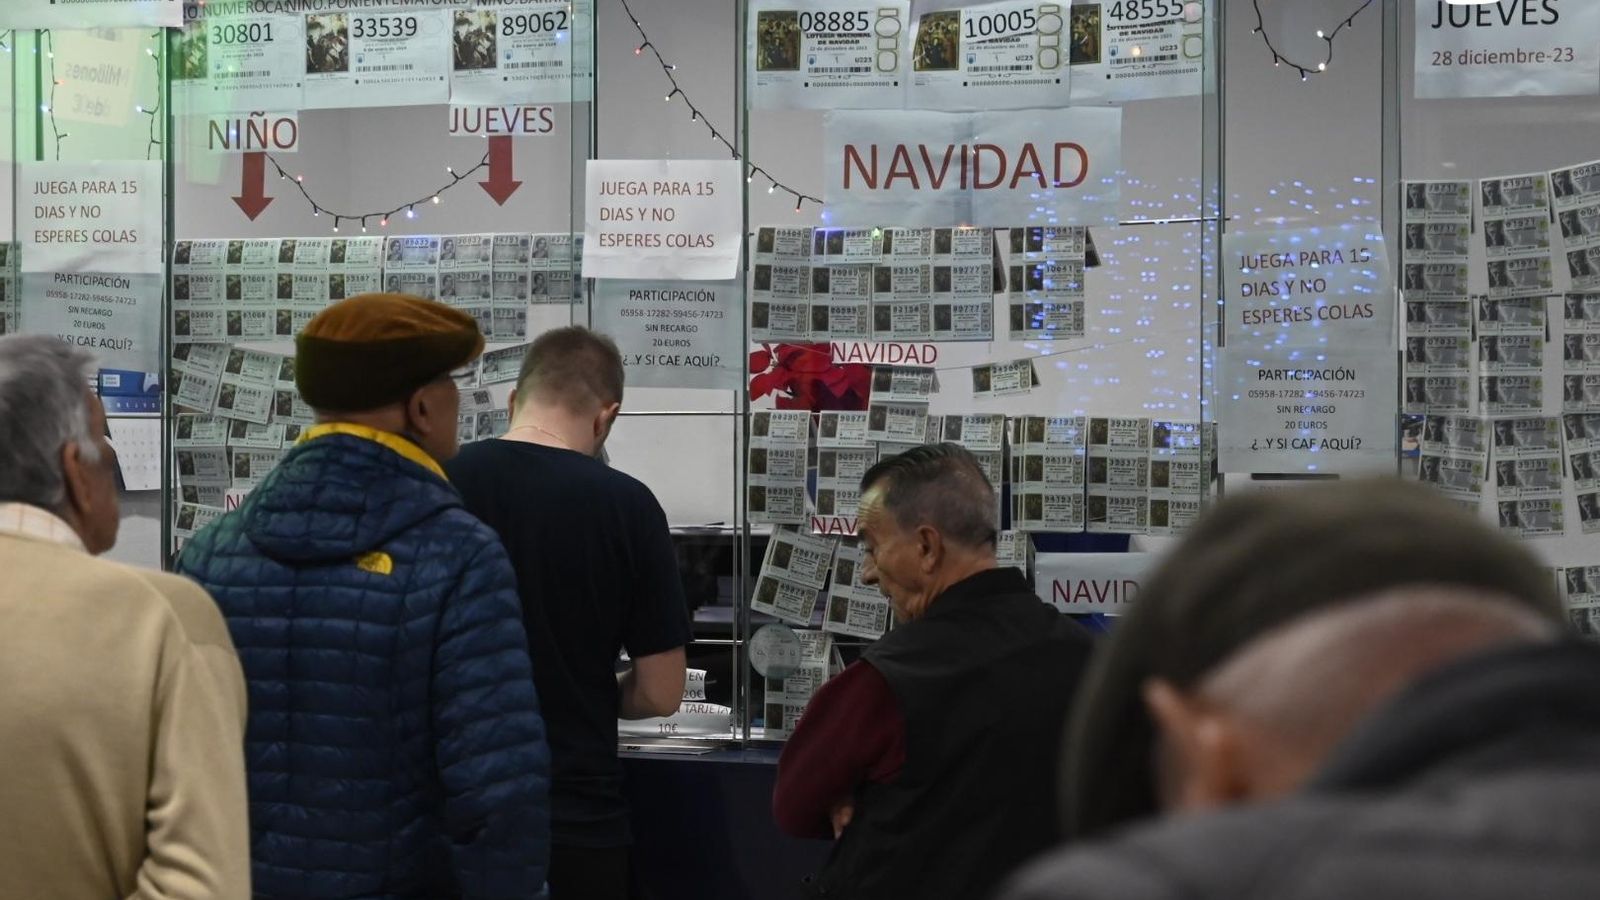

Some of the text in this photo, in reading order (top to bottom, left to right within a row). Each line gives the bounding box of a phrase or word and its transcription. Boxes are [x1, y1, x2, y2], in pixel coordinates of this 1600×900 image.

[1110, 0, 1184, 20] 48555
[1432, 0, 1558, 28] JUEVES
[353, 17, 417, 38] 33539
[502, 10, 568, 36] 89062
[800, 12, 868, 32] 08885
[965, 8, 1036, 38] 10005
[212, 22, 274, 44] 30801
[1432, 48, 1574, 66] 28 diciembre-23
[449, 106, 554, 135] JUEVES
[208, 112, 298, 151] NIÑO
[844, 142, 1088, 190] NAVIDAD
[34, 180, 136, 194] JUEGA PARA 15
[600, 182, 714, 196] JUEGA PARA 15
[34, 205, 100, 219] DIAS Y NO
[600, 208, 675, 221] DIAS Y NO
[34, 229, 137, 243] ESPERES COLAS
[599, 234, 714, 248] ESPERES COLAS
[1240, 248, 1370, 270] JUEGA PARA 15
[54, 272, 130, 290] PARTICIPACIÓN
[1242, 278, 1326, 297] DIAS Y NO
[630, 289, 715, 302] PARTICIPACIÓN
[68, 306, 112, 318] SIN RECARGO
[1242, 304, 1374, 324] ESPERES COLAS
[83, 320, 106, 330] EUROS
[646, 324, 698, 333] SIN RECARGO
[76, 336, 96, 348] CAE
[100, 336, 132, 350] AQUÍ?
[652, 339, 691, 348] 20 EUROS
[831, 342, 938, 364] NAVIDAD
[646, 354, 656, 366] SI
[658, 355, 680, 366] CAE
[684, 354, 720, 368] AQUÍ?
[1258, 366, 1356, 381] PARTICIPACIÓN
[1248, 390, 1365, 399] 05958-172829456-74723
[1276, 405, 1336, 414] SIN RECARGO
[1284, 421, 1328, 430] 20 EUROS
[1277, 438, 1287, 450] SI
[1320, 437, 1362, 451] AQUÍ?
[688, 672, 703, 682] EN
[658, 724, 679, 734] 10€
